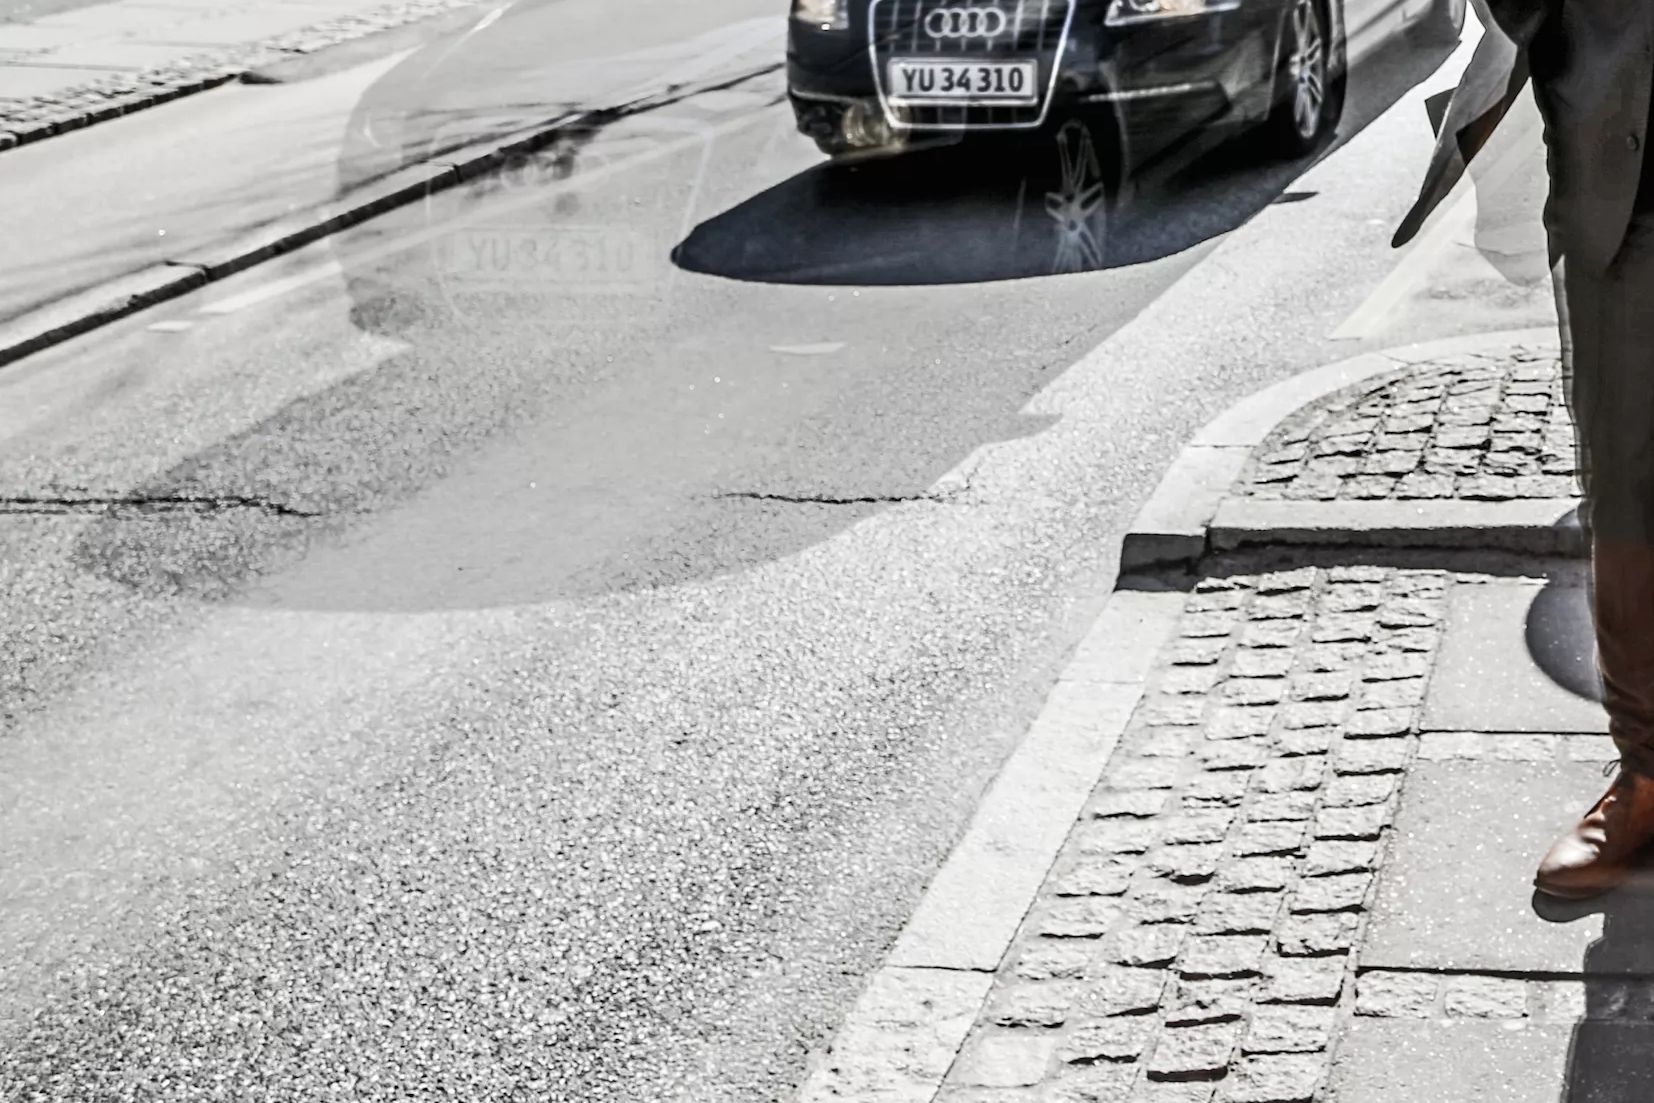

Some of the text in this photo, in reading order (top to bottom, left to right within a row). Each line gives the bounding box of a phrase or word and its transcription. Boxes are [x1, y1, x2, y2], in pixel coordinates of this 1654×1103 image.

[902, 67, 1024, 93] YU 34 310
[467, 237, 511, 271] YU
